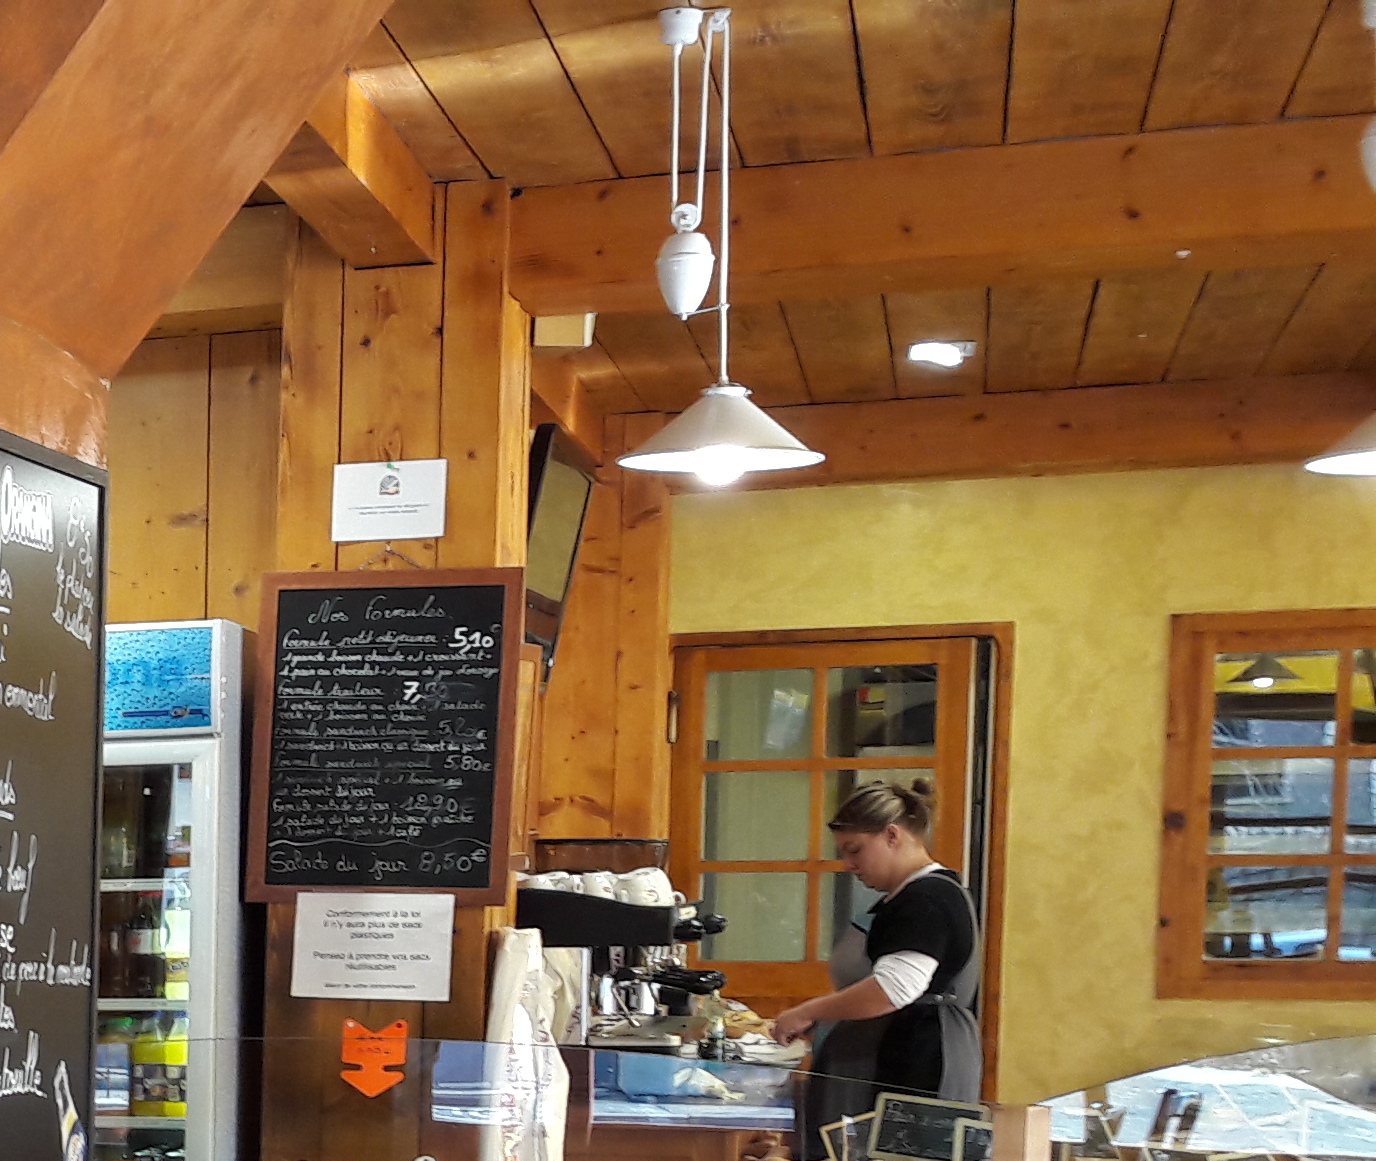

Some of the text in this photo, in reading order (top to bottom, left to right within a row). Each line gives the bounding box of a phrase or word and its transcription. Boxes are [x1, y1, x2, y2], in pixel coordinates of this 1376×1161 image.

[308, 597, 348, 624] Nos
[336, 854, 360, 872] du
[368, 851, 409, 880] jour
